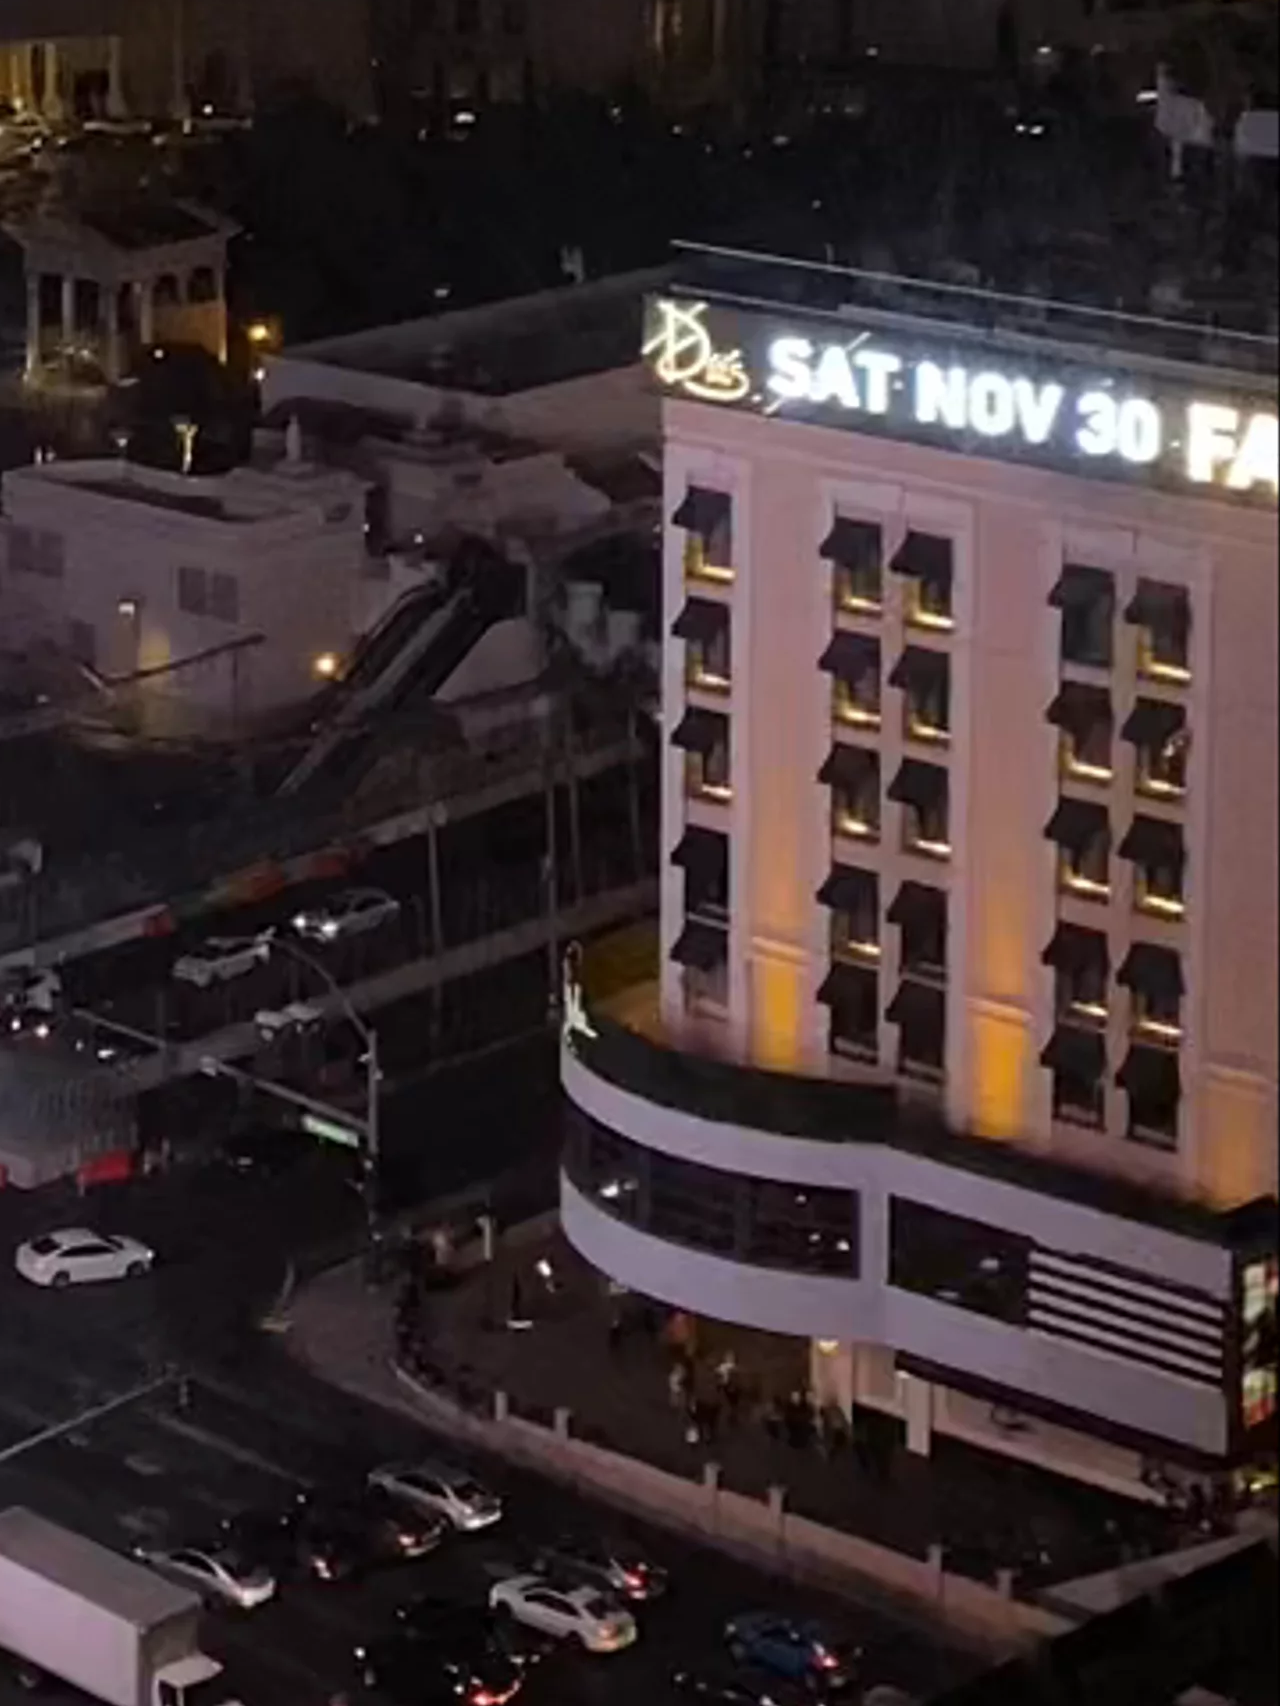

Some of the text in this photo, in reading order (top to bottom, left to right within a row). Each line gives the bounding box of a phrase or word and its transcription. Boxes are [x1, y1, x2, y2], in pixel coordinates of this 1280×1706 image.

[766, 336, 904, 416] SAT
[914, 357, 1066, 444] NOV
[1074, 389, 1162, 464] 30
